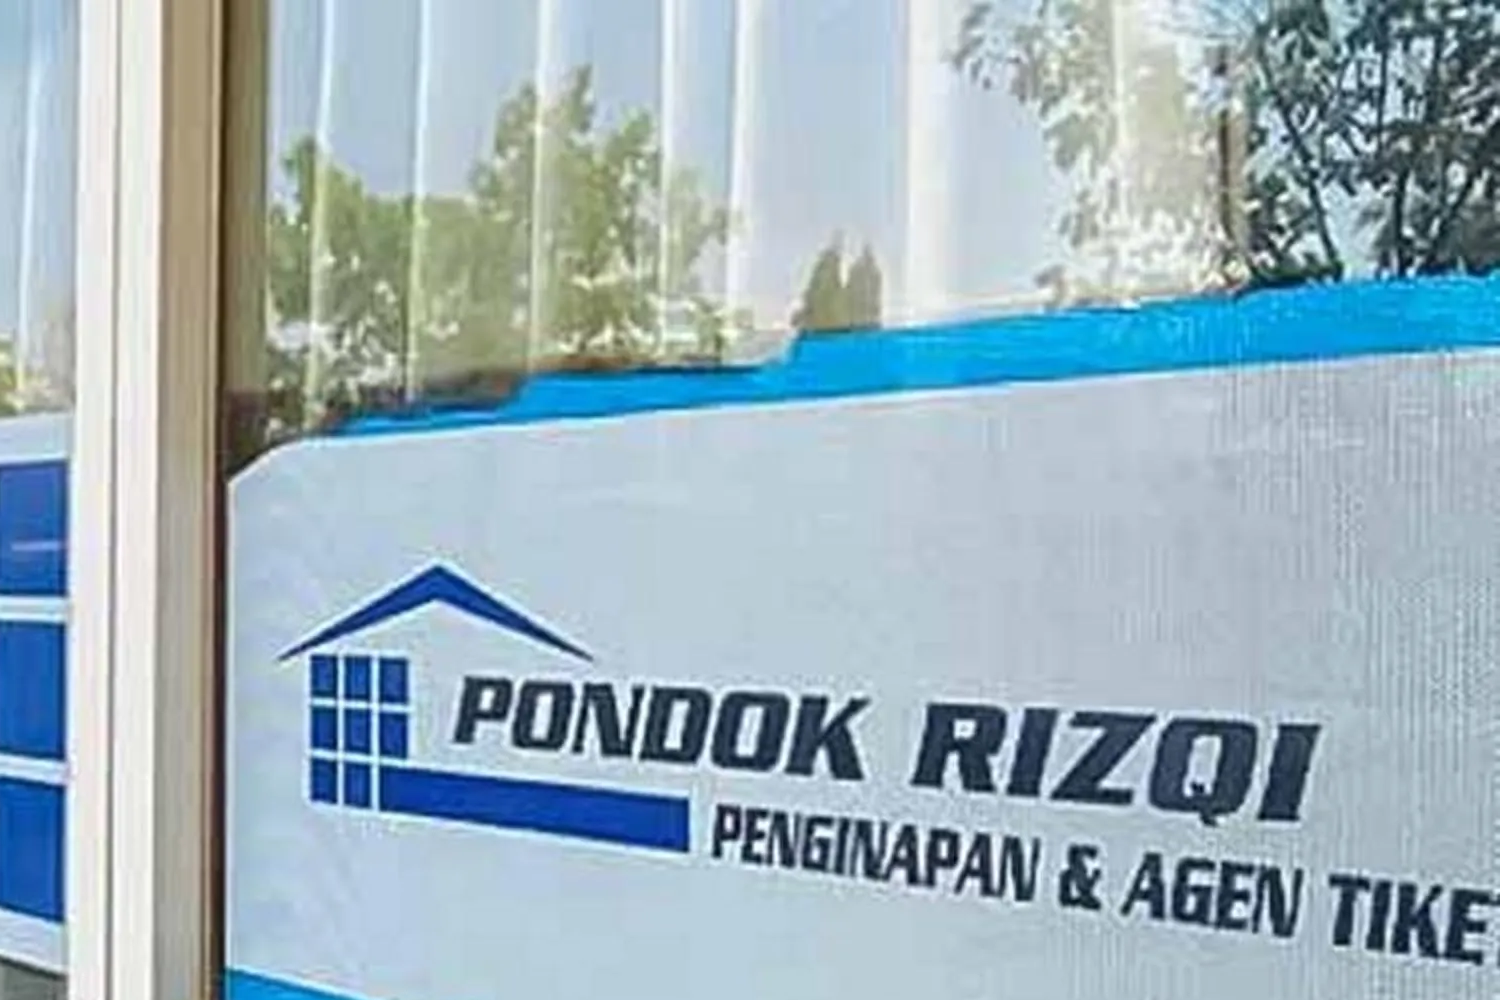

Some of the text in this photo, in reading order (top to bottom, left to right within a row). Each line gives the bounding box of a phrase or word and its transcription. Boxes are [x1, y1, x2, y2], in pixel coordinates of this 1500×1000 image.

[452, 675, 1322, 826] PONDOK RIZQI
[712, 803, 1500, 967] PENGINAPAN & AGEN TIKE
